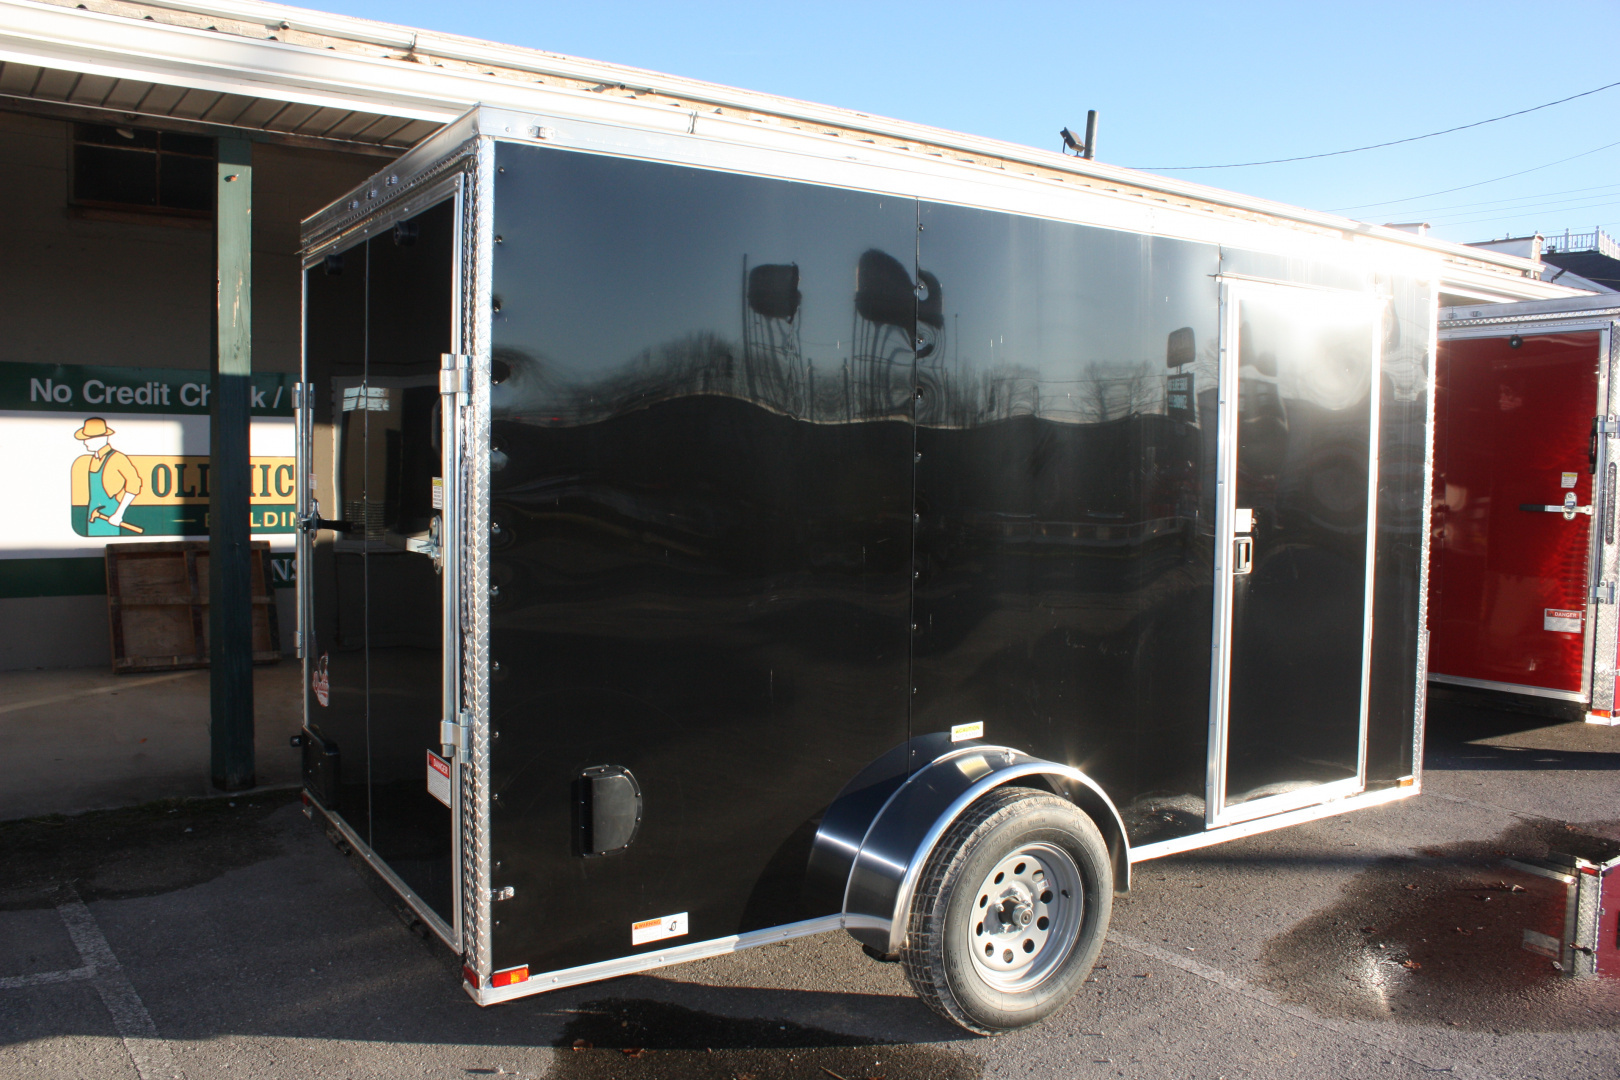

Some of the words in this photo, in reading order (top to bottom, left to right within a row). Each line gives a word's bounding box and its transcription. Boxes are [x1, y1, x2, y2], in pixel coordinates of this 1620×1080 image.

[30, 378, 73, 403] No
[82, 379, 171, 406] Credit
[180, 383, 267, 408] Chk
[639, 919, 661, 928] WARNING
